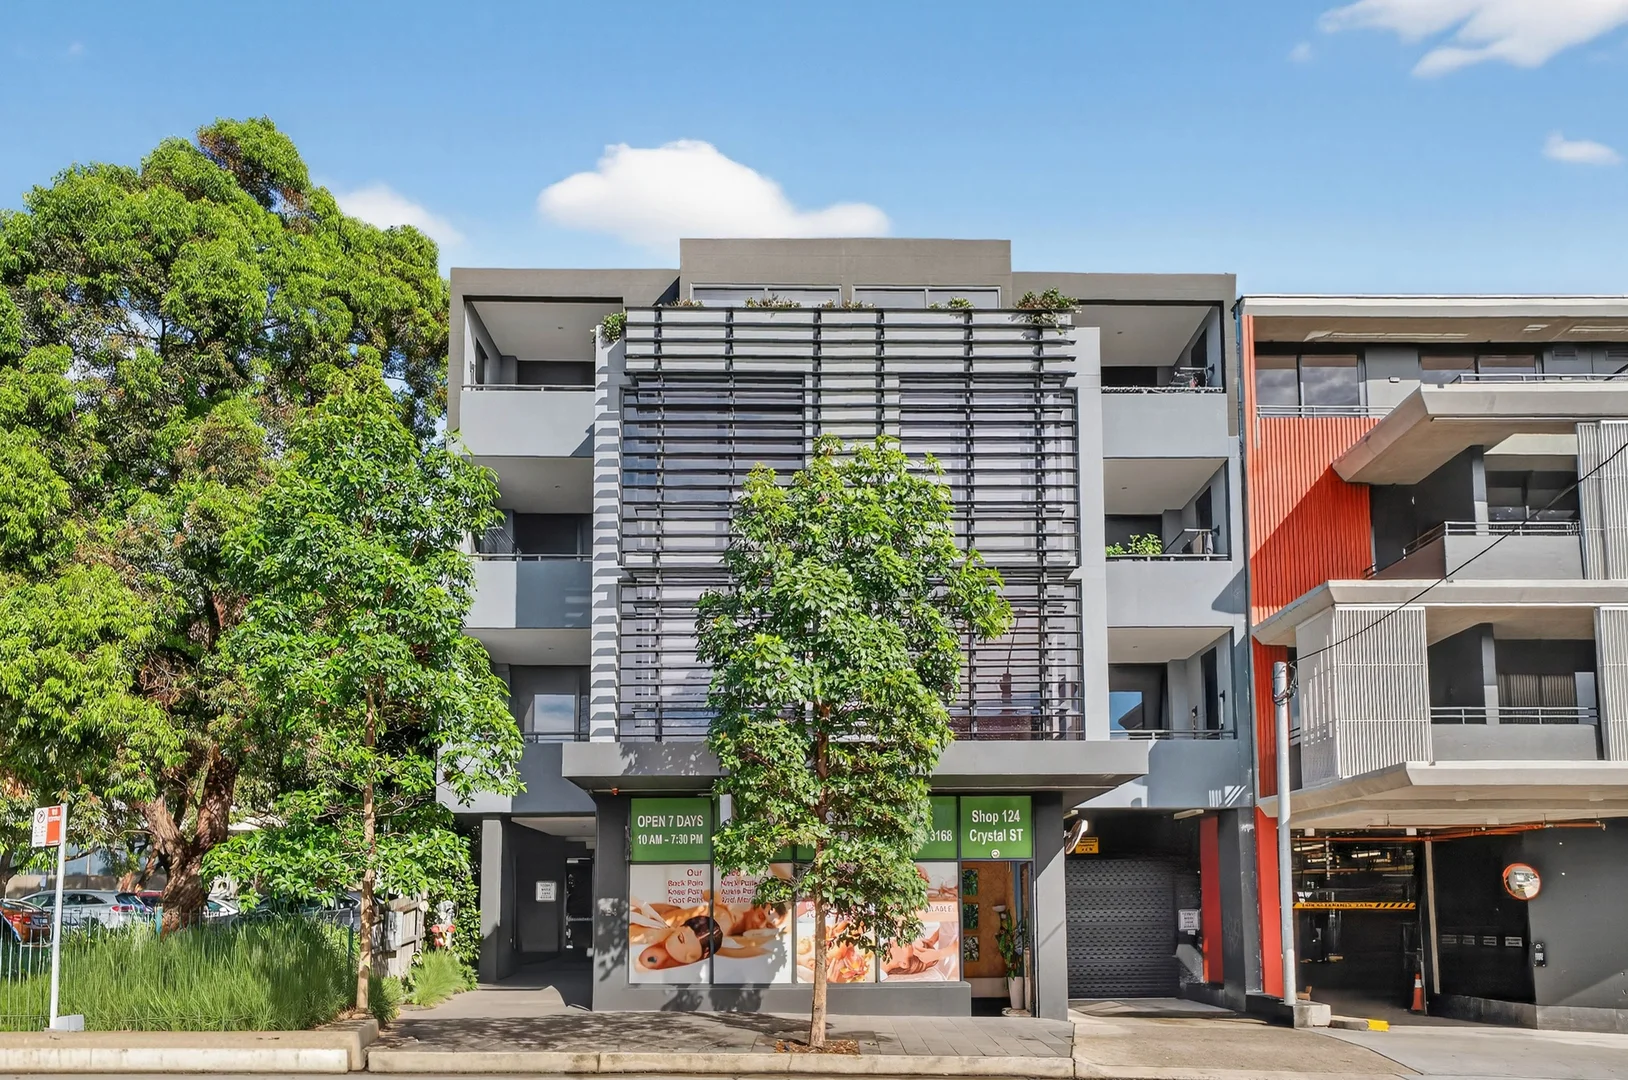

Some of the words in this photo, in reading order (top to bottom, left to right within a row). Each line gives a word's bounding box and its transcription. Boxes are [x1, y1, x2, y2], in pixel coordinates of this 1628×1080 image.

[637, 815, 666, 828] OPEN
[668, 815, 674, 828] 7
[676, 814, 704, 827] DAYS
[971, 809, 999, 826] Shop
[1002, 809, 1021, 823] 124
[638, 834, 648, 845] 10
[648, 834, 663, 845] AM
[670, 834, 688, 845] 7:30
[690, 833, 704, 845] PM
[969, 828, 1007, 846] Crystal
[1009, 828, 1024, 842] ST
[686, 868, 703, 877] Our
